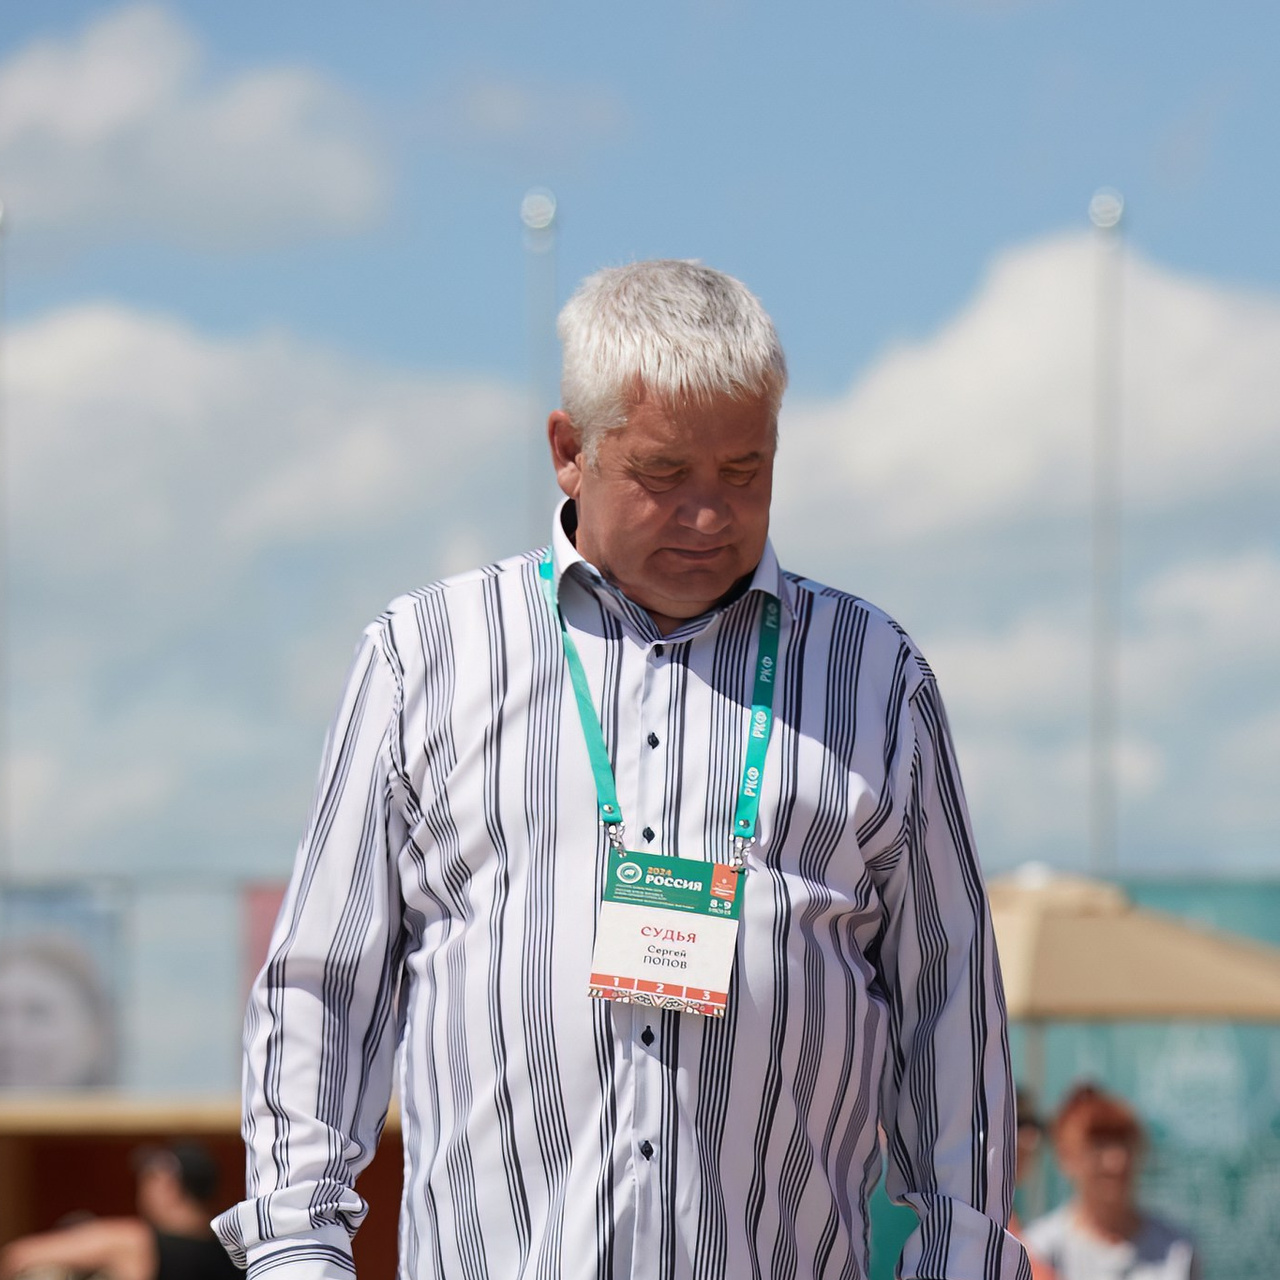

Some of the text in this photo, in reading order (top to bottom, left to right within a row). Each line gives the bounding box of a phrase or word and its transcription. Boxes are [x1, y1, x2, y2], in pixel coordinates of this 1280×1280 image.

[645, 874, 702, 892] РОССИЯ
[641, 926, 696, 944] СУДЬЯ
[647, 945, 687, 958] Сергей
[643, 955, 688, 970] ПОПОВ
[613, 977, 710, 1000] 1 2 3
